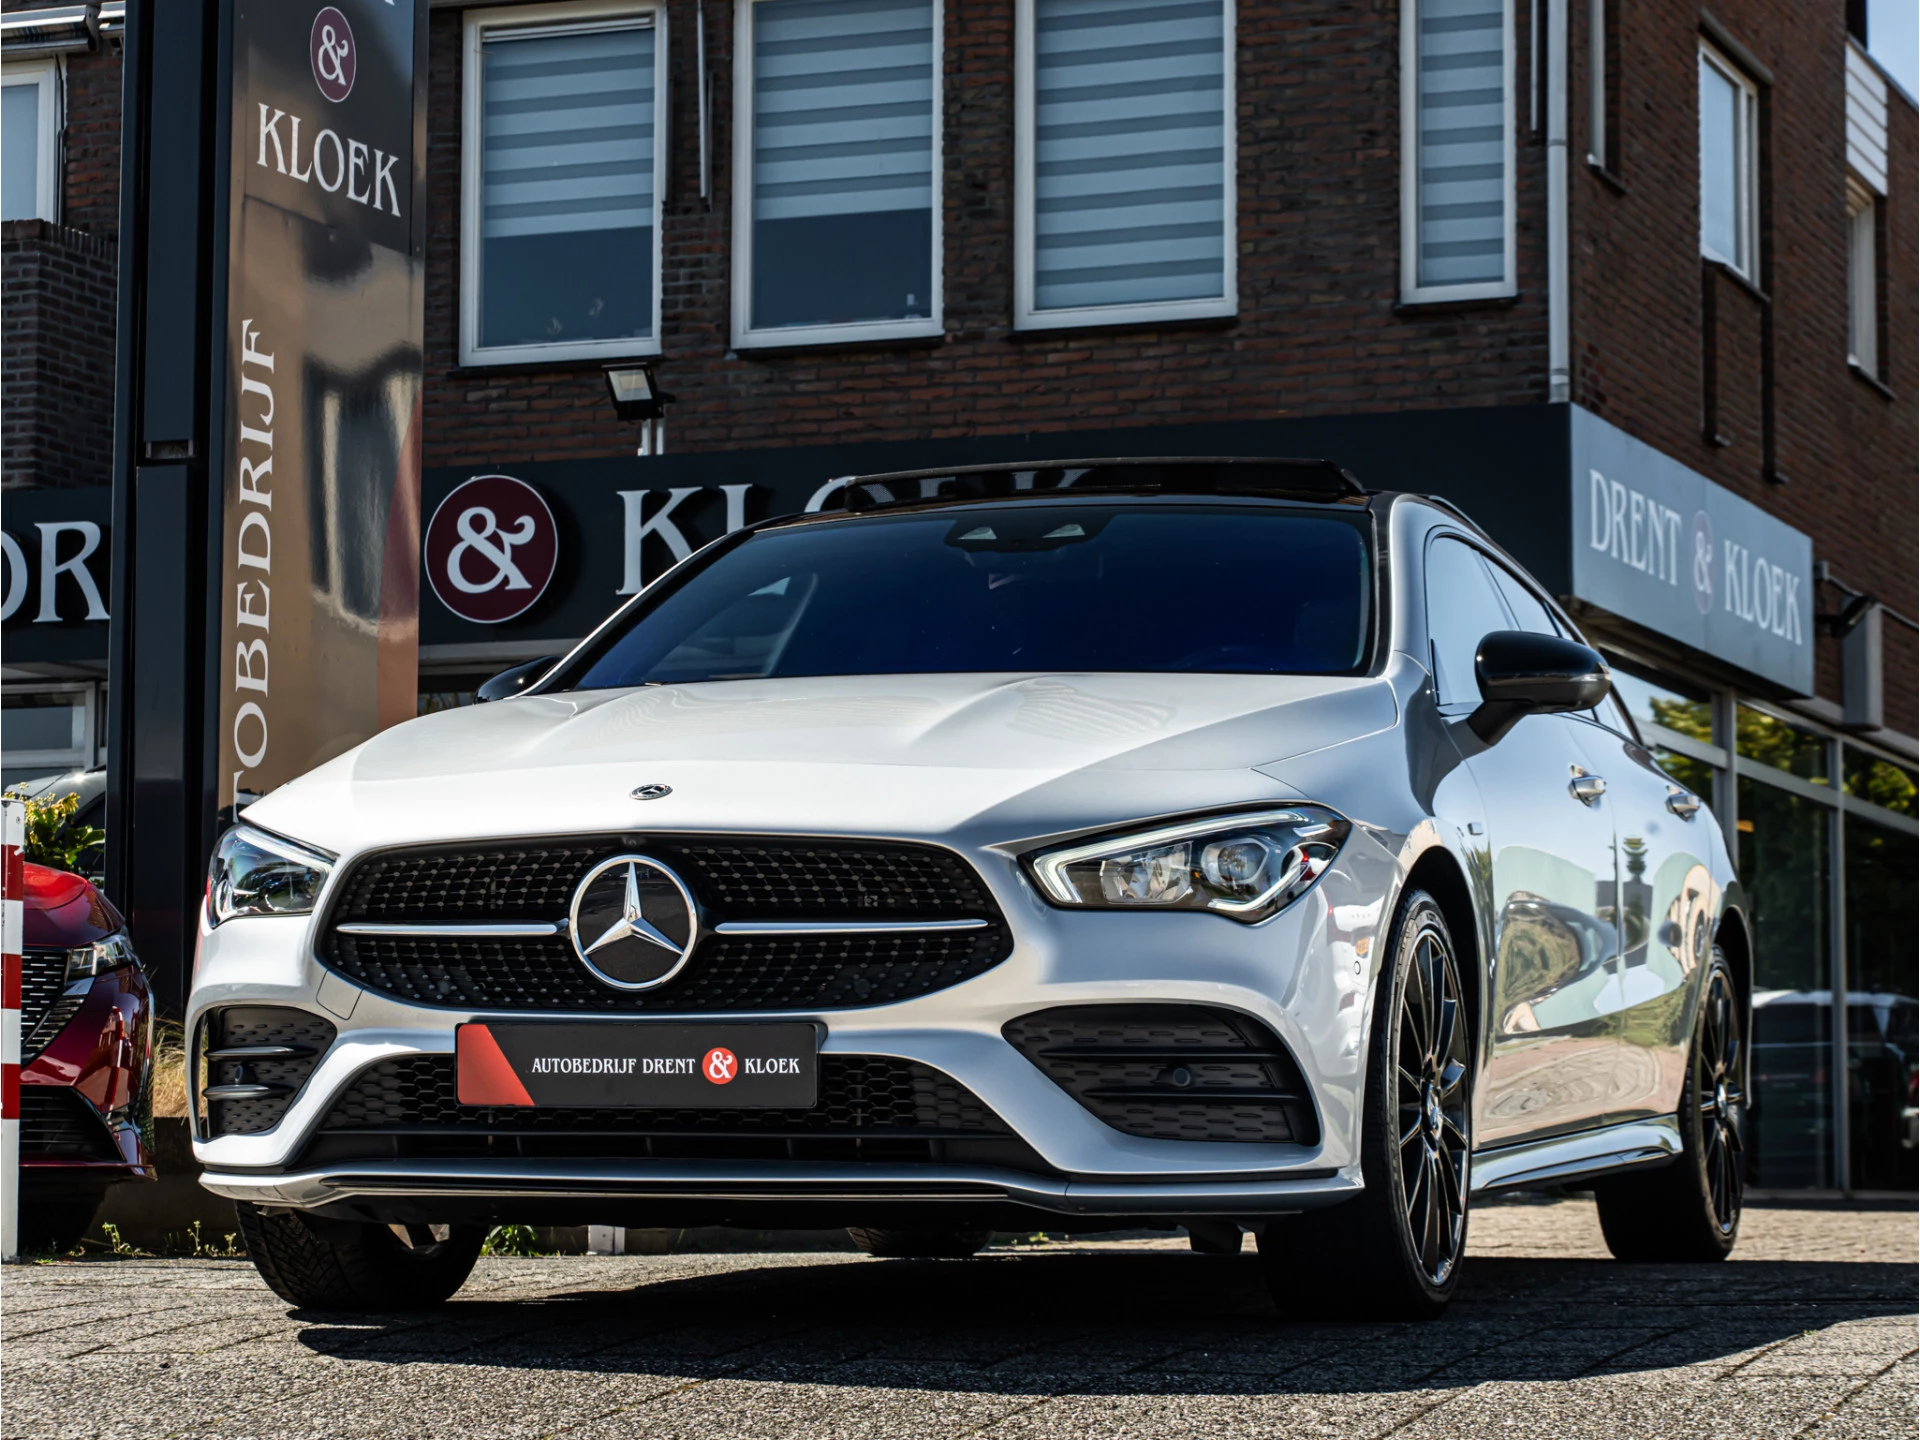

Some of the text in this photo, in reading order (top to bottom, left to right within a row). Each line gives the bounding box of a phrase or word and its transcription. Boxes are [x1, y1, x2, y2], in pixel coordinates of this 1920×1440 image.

[318, 25, 349, 86] &
[256, 102, 402, 218] KLOEK
[447, 506, 536, 594] &
[1590, 468, 1803, 646] DRENT & KLOEK
[531, 1051, 801, 1079] AUTOBEDRIJF DRENT & KLOEK
